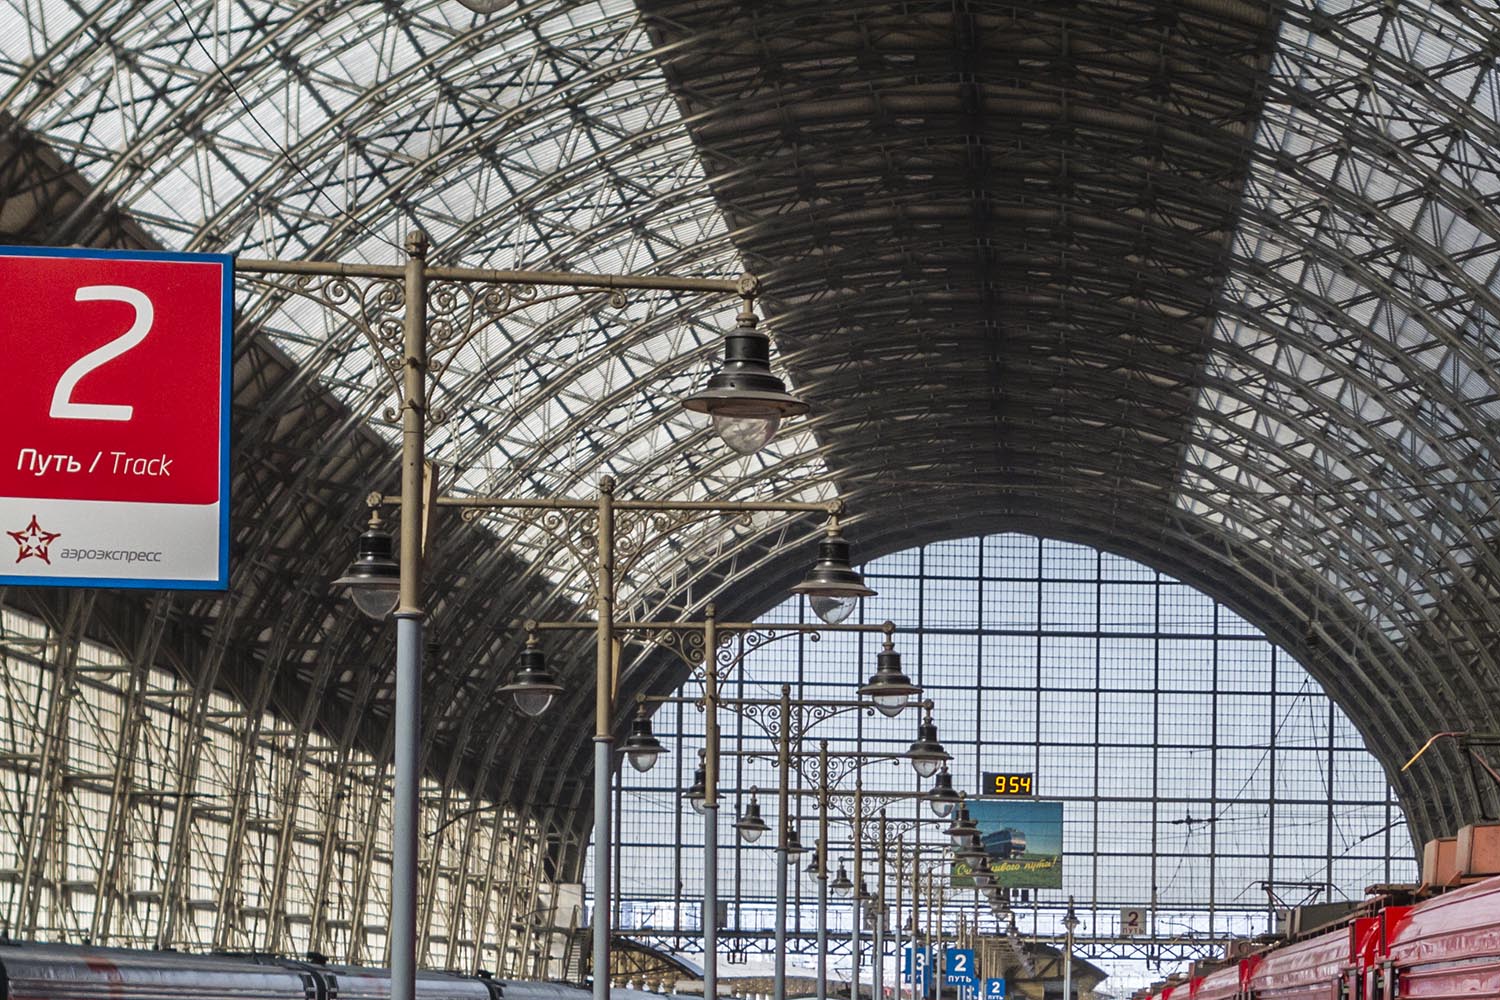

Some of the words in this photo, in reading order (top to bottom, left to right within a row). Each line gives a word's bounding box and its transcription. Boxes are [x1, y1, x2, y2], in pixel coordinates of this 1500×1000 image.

[49, 285, 154, 421] 2
[17, 448, 82, 476] Путь
[110, 451, 173, 477] Track
[60, 548, 162, 563] аэроэкспресс
[1128, 911, 1139, 927] 2
[916, 953, 926, 971] 3
[954, 953, 967, 972] 2
[991, 981, 1001, 994] 2
